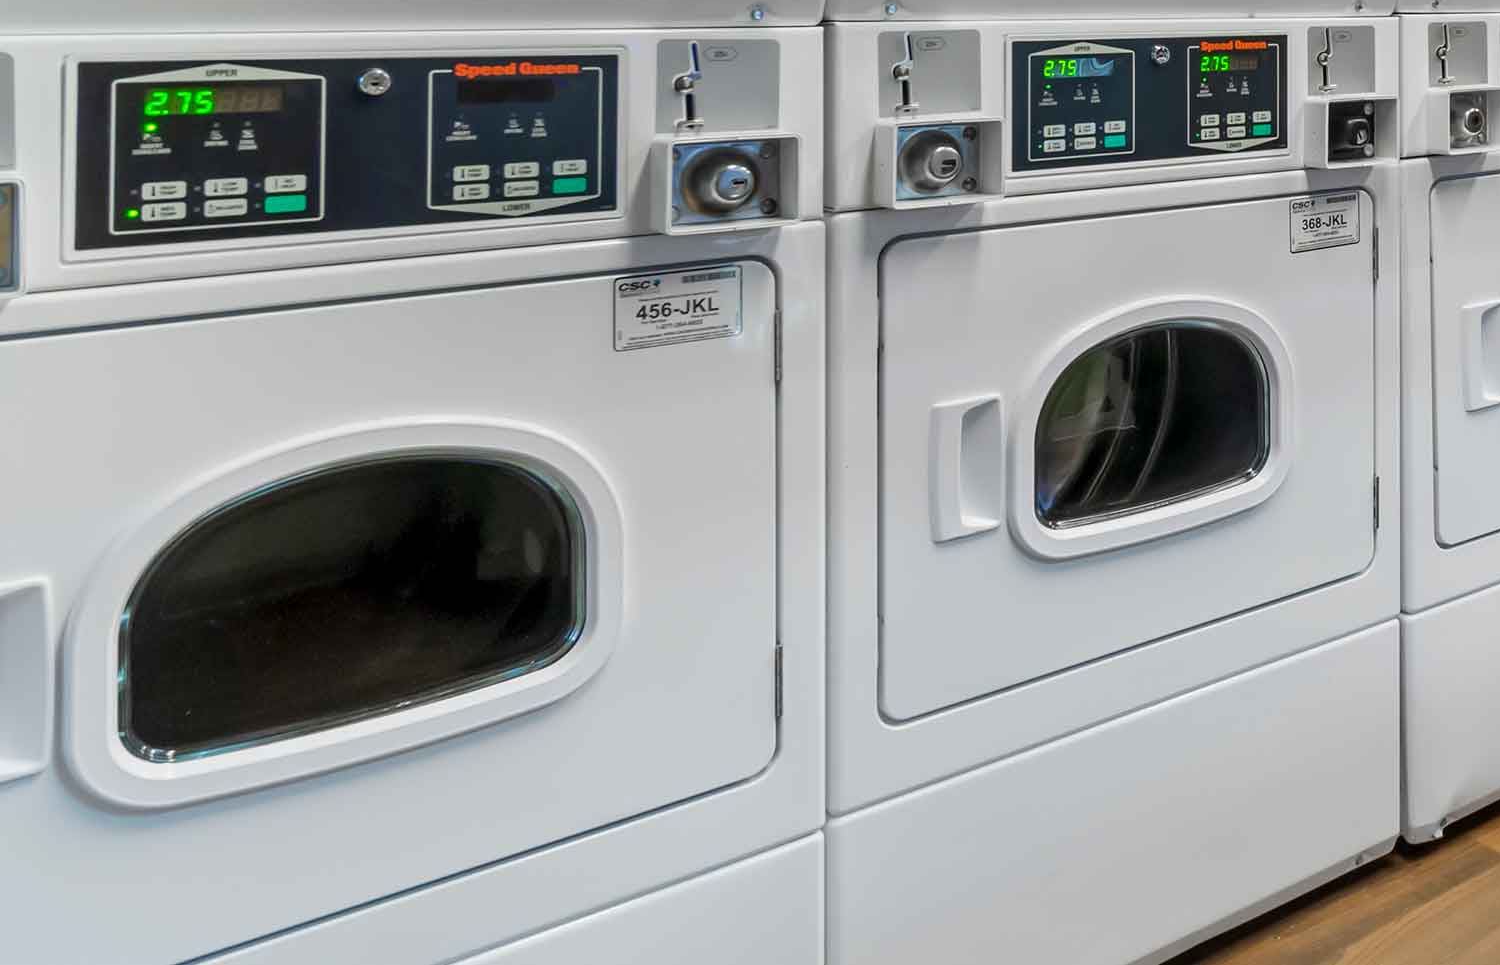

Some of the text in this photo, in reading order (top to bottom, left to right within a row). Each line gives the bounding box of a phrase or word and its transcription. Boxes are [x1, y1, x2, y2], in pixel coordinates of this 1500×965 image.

[1200, 40, 1233, 52] Speed
[454, 62, 580, 80] Speed Queen
[1043, 59, 1077, 77] 2.75
[1200, 56, 1229, 72] 2.75
[145, 90, 214, 116] 2.75
[1302, 214, 1347, 230] 368-JKL
[618, 280, 651, 292] CSC
[635, 296, 720, 320] 456-JKL
